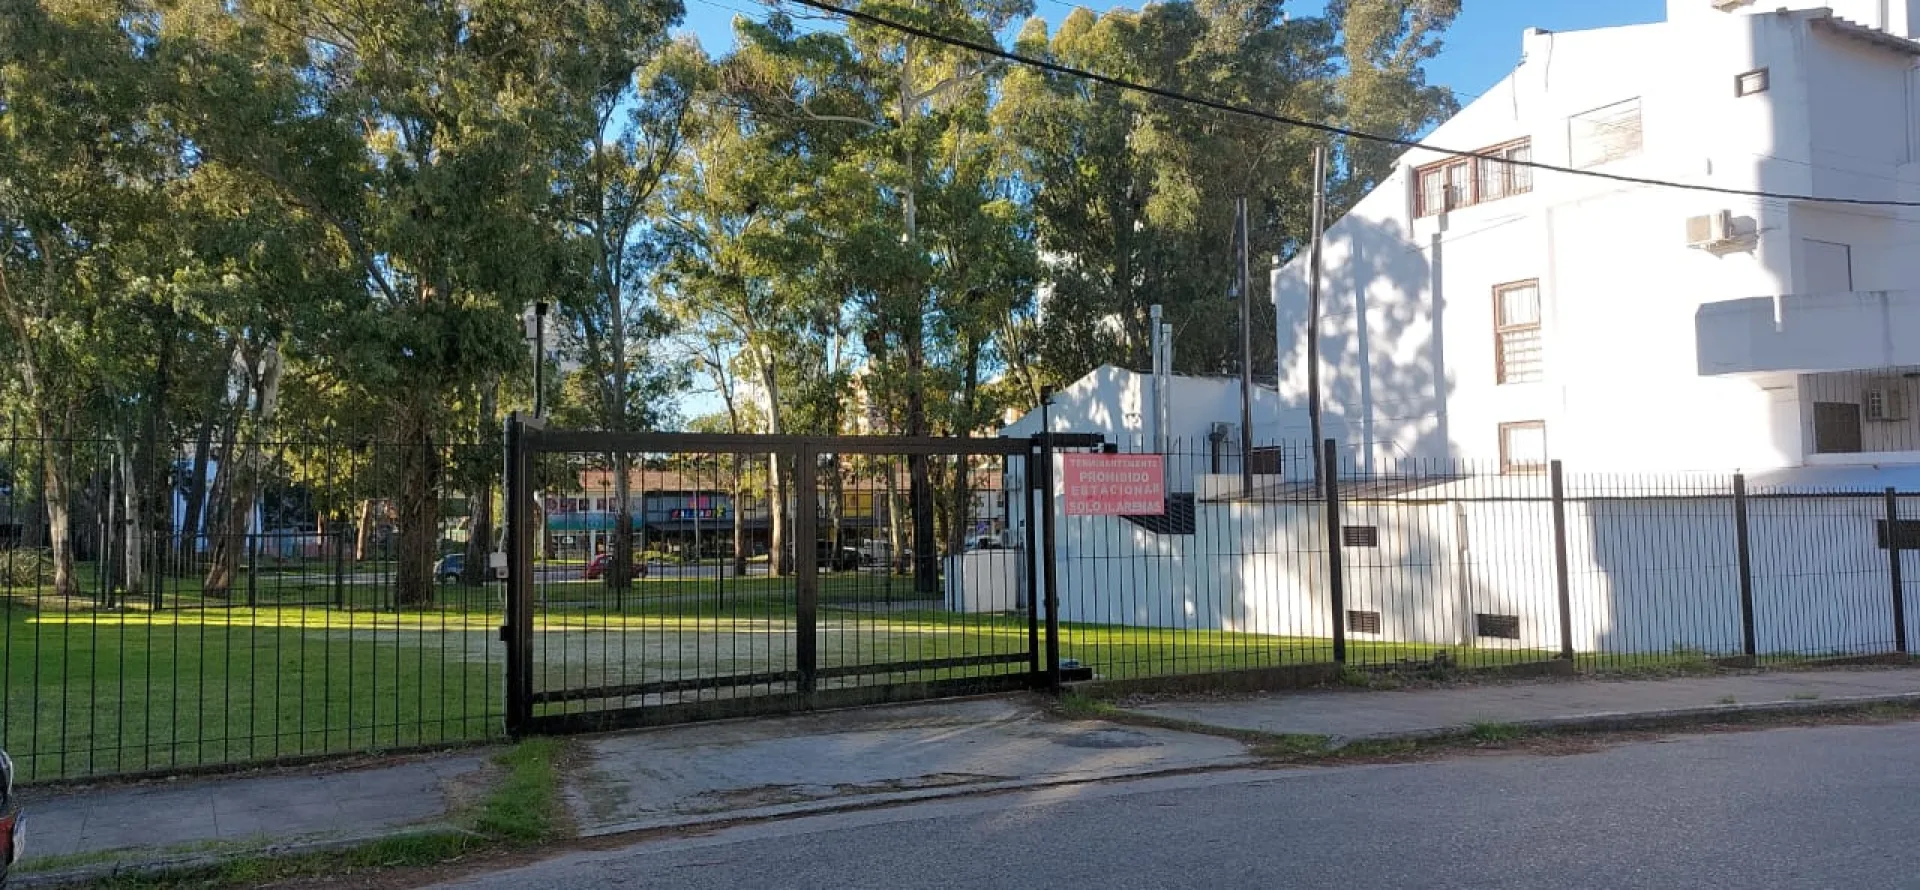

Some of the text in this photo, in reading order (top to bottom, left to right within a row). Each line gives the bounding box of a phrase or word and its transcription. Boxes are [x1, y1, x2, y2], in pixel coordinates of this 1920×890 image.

[1079, 471, 1149, 482] PROHIBIDO
[1071, 483, 1160, 496] ESTACIONAR
[1069, 501, 1101, 513] SOLO
